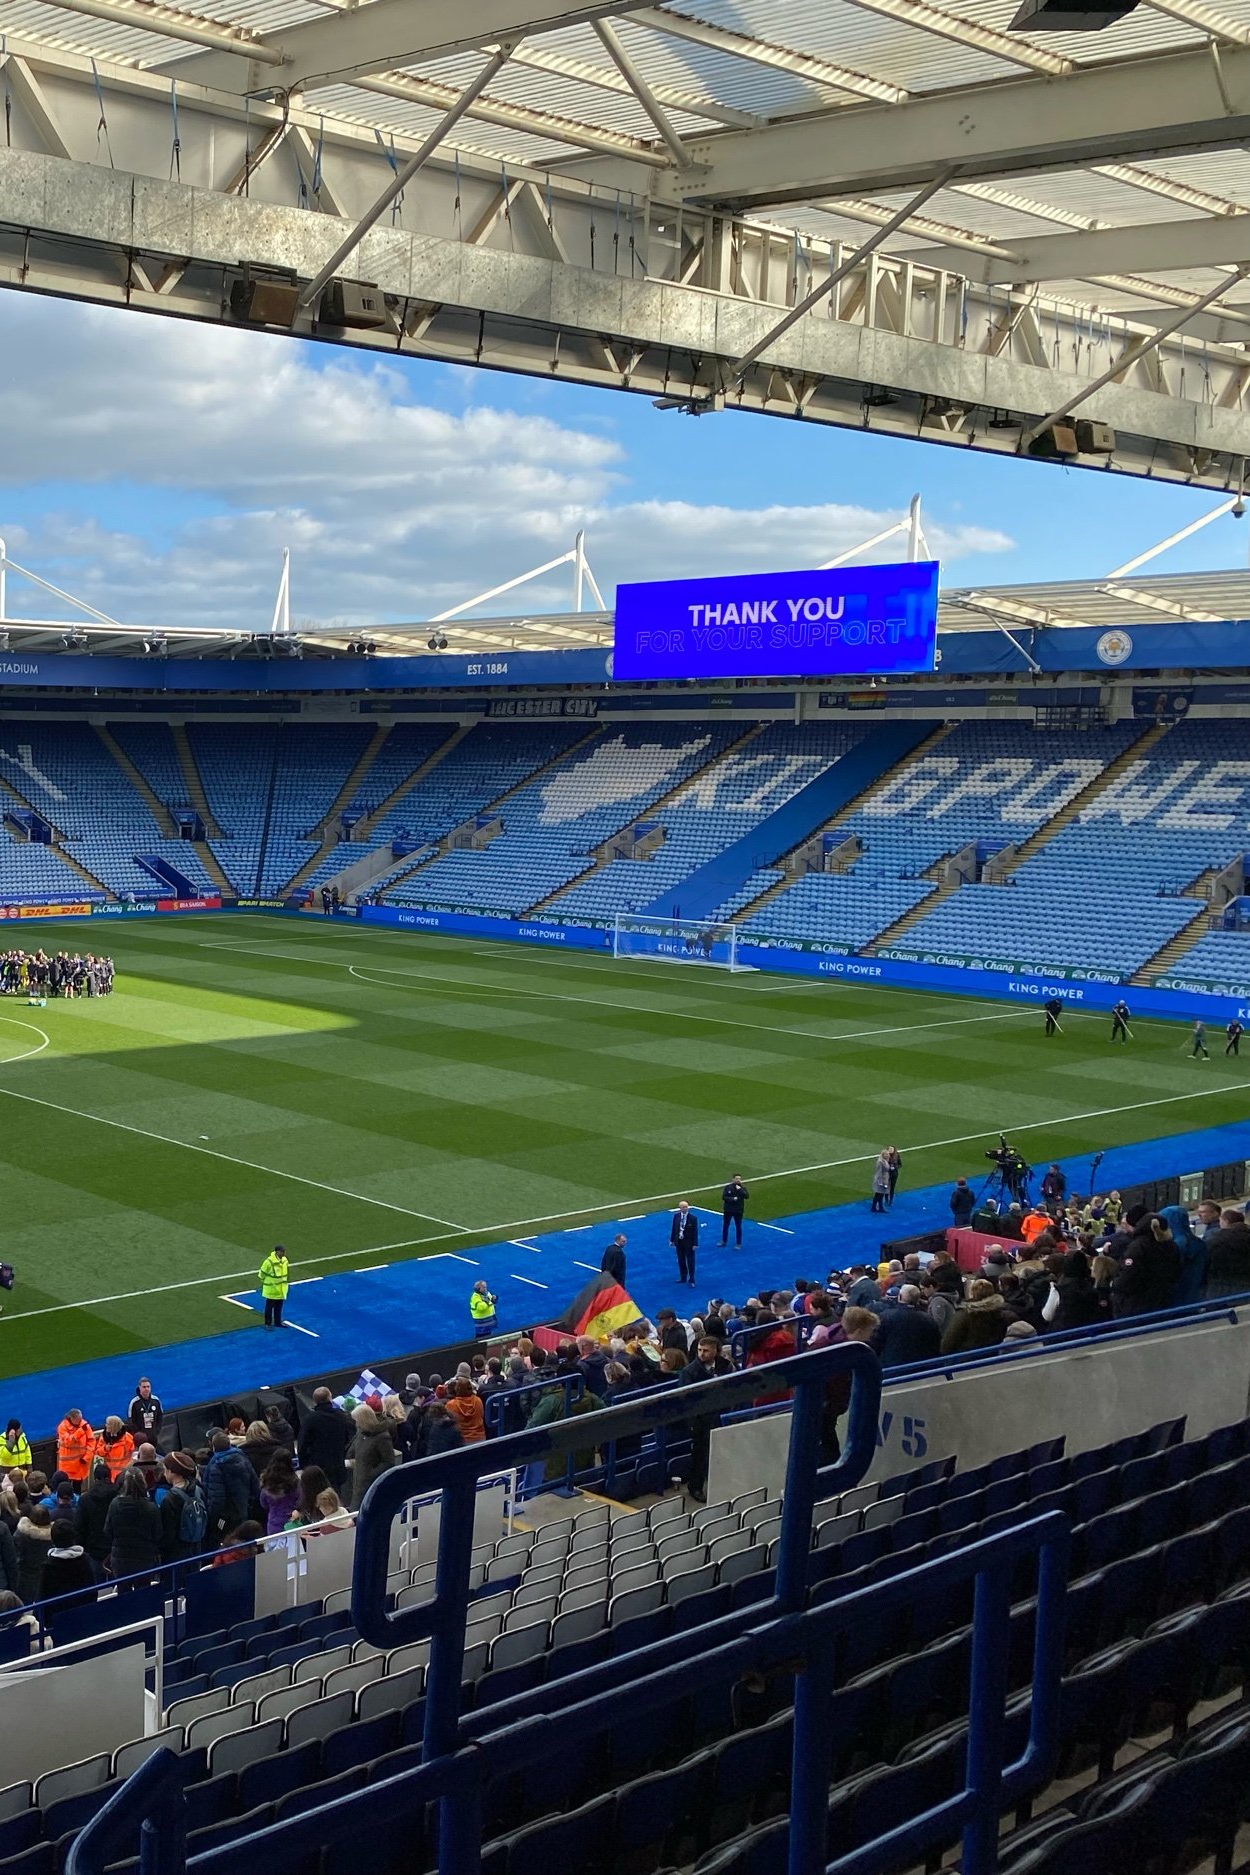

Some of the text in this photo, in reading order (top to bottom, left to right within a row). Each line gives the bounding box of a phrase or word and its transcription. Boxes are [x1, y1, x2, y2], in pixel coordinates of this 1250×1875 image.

[688, 596, 845, 626] THANK YOU
[636, 618, 907, 654] FOR YOUR SUPPORT
[467, 663, 508, 675] EST. 1884
[564, 699, 598, 716] CITY
[25, 908, 51, 916] DHL
[102, 903, 123, 913] Chang
[136, 902, 156, 912] Chang
[406, 901, 424, 911] Chang
[398, 915, 439, 926] KING POWER
[492, 910, 511, 920] Chang
[539, 915, 559, 926] Chang
[571, 918, 592, 929] Chang
[518, 928, 566, 940] KING POWER
[640, 925, 662, 937] Chang
[735, 934, 759, 947] Chang
[777, 938, 803, 951] Chang
[822, 942, 849, 956] Chang
[890, 950, 919, 962] Chang
[936, 955, 965, 969] Chang
[819, 961, 882, 976] KING POWER
[984, 959, 1015, 974] Chang
[1034, 963, 1066, 979] Chang
[1086, 970, 1120, 985] Chang
[1008, 982, 1084, 1000] KING POWER
[1171, 980, 1208, 993] Chang
